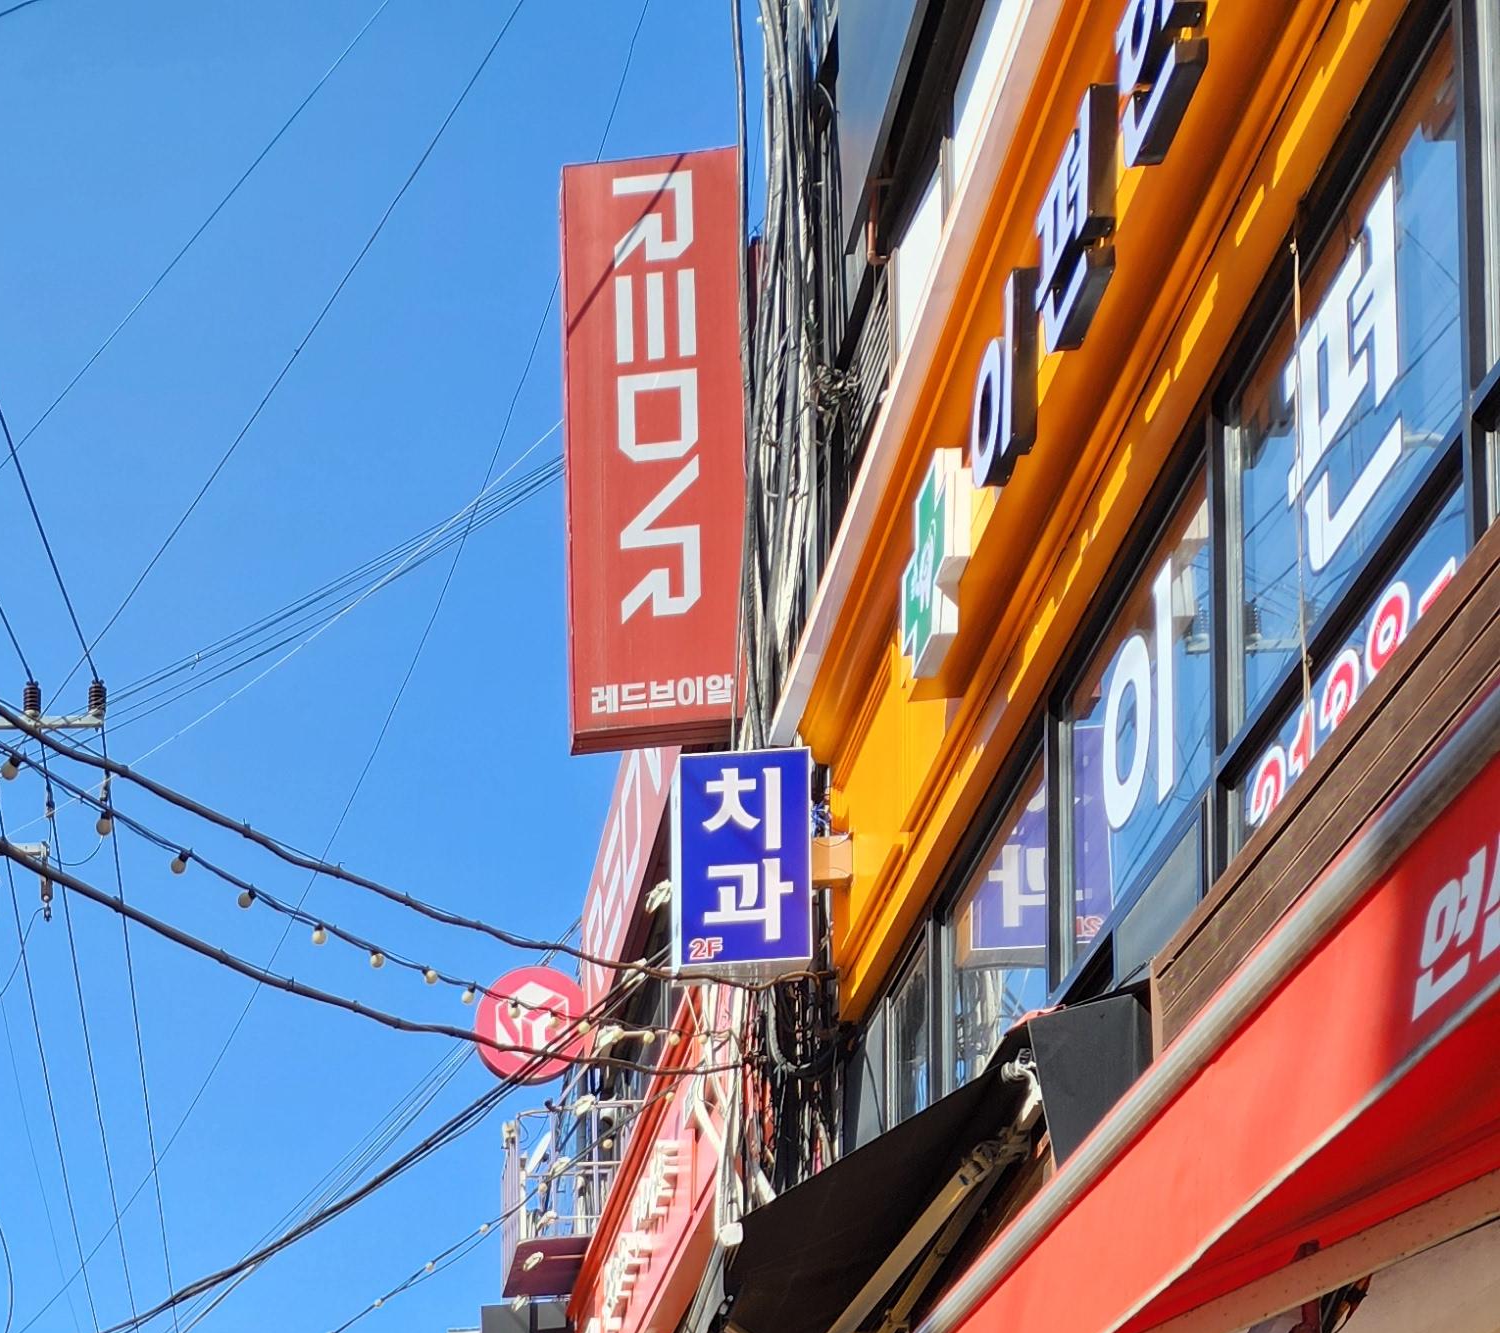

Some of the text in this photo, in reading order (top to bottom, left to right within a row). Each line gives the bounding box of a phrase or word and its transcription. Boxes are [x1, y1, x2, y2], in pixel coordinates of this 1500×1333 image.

[590, 674, 735, 715] 레드브이알
[701, 766, 794, 943] 치과
[688, 937, 724, 961] 2F
